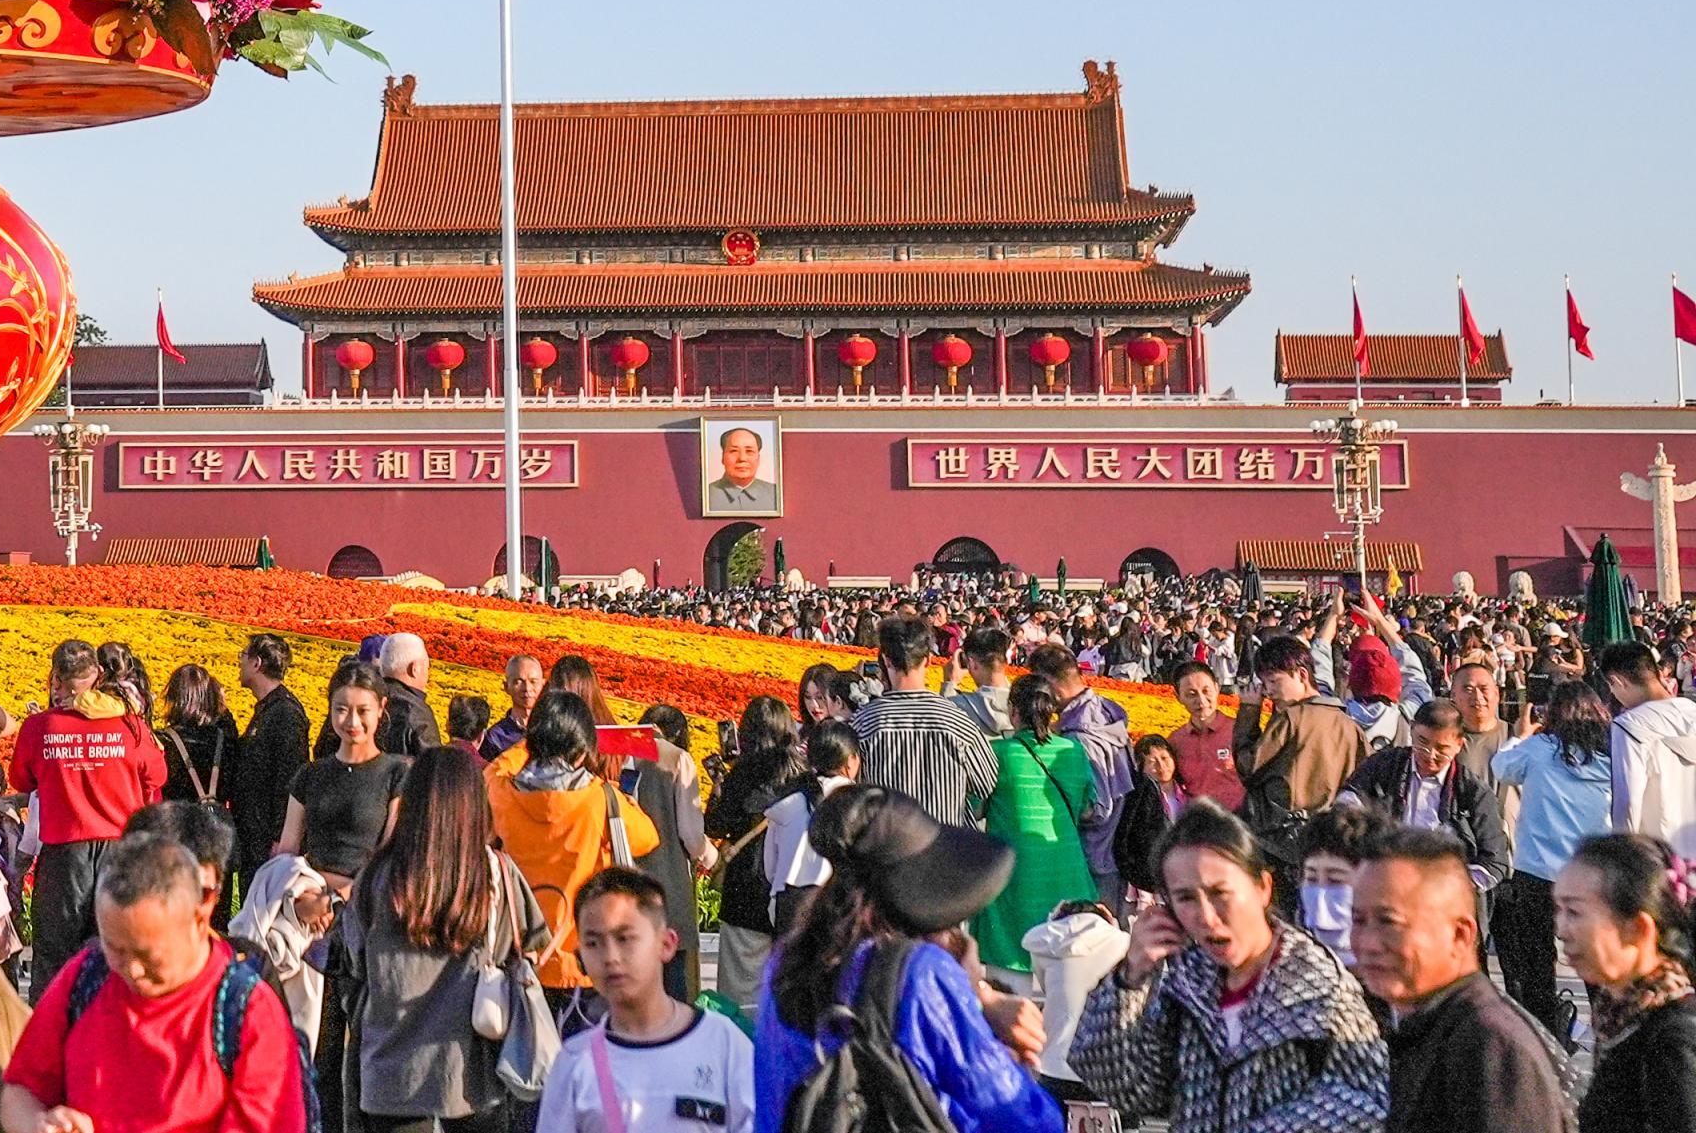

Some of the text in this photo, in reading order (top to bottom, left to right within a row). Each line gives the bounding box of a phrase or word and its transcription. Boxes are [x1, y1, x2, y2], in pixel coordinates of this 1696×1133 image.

[143, 449, 552, 481] 中华人民共和国万岁
[936, 447, 1374, 481] 世界人民大团结万
[43, 734, 82, 744] SUNDAY'S
[86, 734, 103, 743] FUN
[43, 746, 125, 760] CHARLIE BROWN
